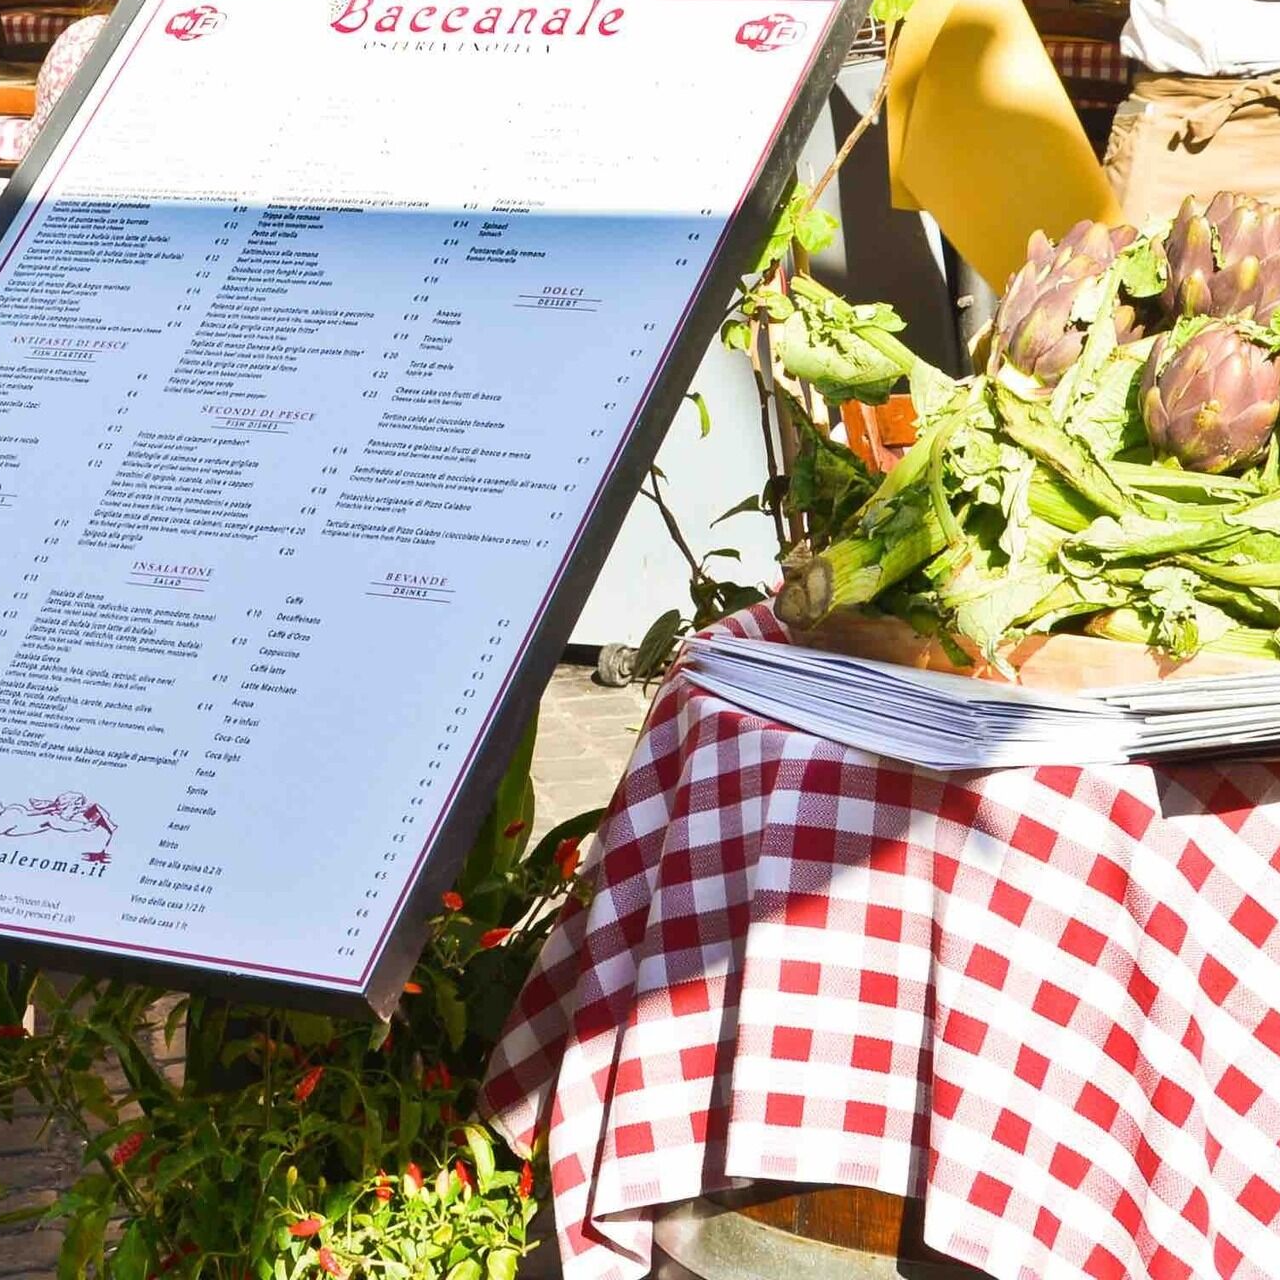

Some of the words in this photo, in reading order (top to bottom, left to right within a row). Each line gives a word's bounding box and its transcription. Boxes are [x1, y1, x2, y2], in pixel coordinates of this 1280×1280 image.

[261, 211, 283, 221] Trippa
[282, 211, 296, 220] alla
[295, 213, 321, 221] romana
[241, 247, 280, 256] Saltimbocca
[280, 249, 294, 257] alla
[469, 246, 505, 256] Puntarelle
[504, 248, 519, 257] alla
[518, 250, 546, 258] romana
[542, 285, 584, 296] DOLCI
[537, 297, 581, 307] DESSERT
[435, 309, 462, 318] Ananas
[10, 335, 73, 346] ANTIPASTI
[75, 338, 90, 348] DI
[92, 340, 129, 350] PESCE
[31, 348, 51, 357] FISH
[52, 350, 93, 359] STARTERS
[409, 359, 428, 369] Torta
[436, 362, 454, 371] mele
[167, 375, 190, 385] Filetto
[196, 379, 215, 387] pepe
[214, 380, 234, 388] verde
[394, 385, 421, 395] Cheese
[420, 388, 438, 396] cake
[437, 390, 452, 398] con
[451, 390, 472, 399] frutti
[479, 392, 502, 401] bosco
[200, 404, 256, 417] SECONDI
[259, 408, 275, 419] DI
[277, 410, 316, 421] PESCE
[225, 418, 246, 427] FISH
[246, 420, 278, 430] DISHES
[381, 411, 407, 422] Tortino
[406, 414, 428, 424] caldo
[435, 417, 472, 427] cioccolato
[471, 419, 505, 429] fondente
[132, 561, 213, 577] INSALATONE
[152, 576, 182, 587] SALAD
[385, 572, 448, 587] BEVANDE
[392, 586, 428, 598] DRINKS
[276, 612, 321, 625] Decaffeinato
[13, 650, 41, 661] Insalata
[40, 653, 61, 664] Greca
[258, 646, 300, 659] Cappuccino
[268, 665, 286, 675] latte
[240, 680, 260, 691] Latte
[260, 682, 297, 695] Macchiato
[231, 697, 255, 708] Acqua
[204, 749, 223, 760] Coca
[222, 752, 241, 763] light
[194, 767, 216, 778] Fanta
[185, 784, 209, 796] Sprite
[176, 803, 217, 816] Limoncello
[167, 821, 191, 831] Amari
[157, 838, 179, 850] Mirto
[148, 856, 167, 868] Birre
[166, 860, 182, 870] alla
[181, 863, 202, 873] spina
[138, 874, 158, 886] Birre
[157, 878, 172, 888] alla
[171, 882, 193, 892] spina
[130, 893, 147, 904] Vino
[147, 896, 166, 907] della
[166, 901, 184, 910] casa
[120, 912, 138, 923] Vino
[137, 914, 157, 926] della
[156, 919, 174, 929] casa
